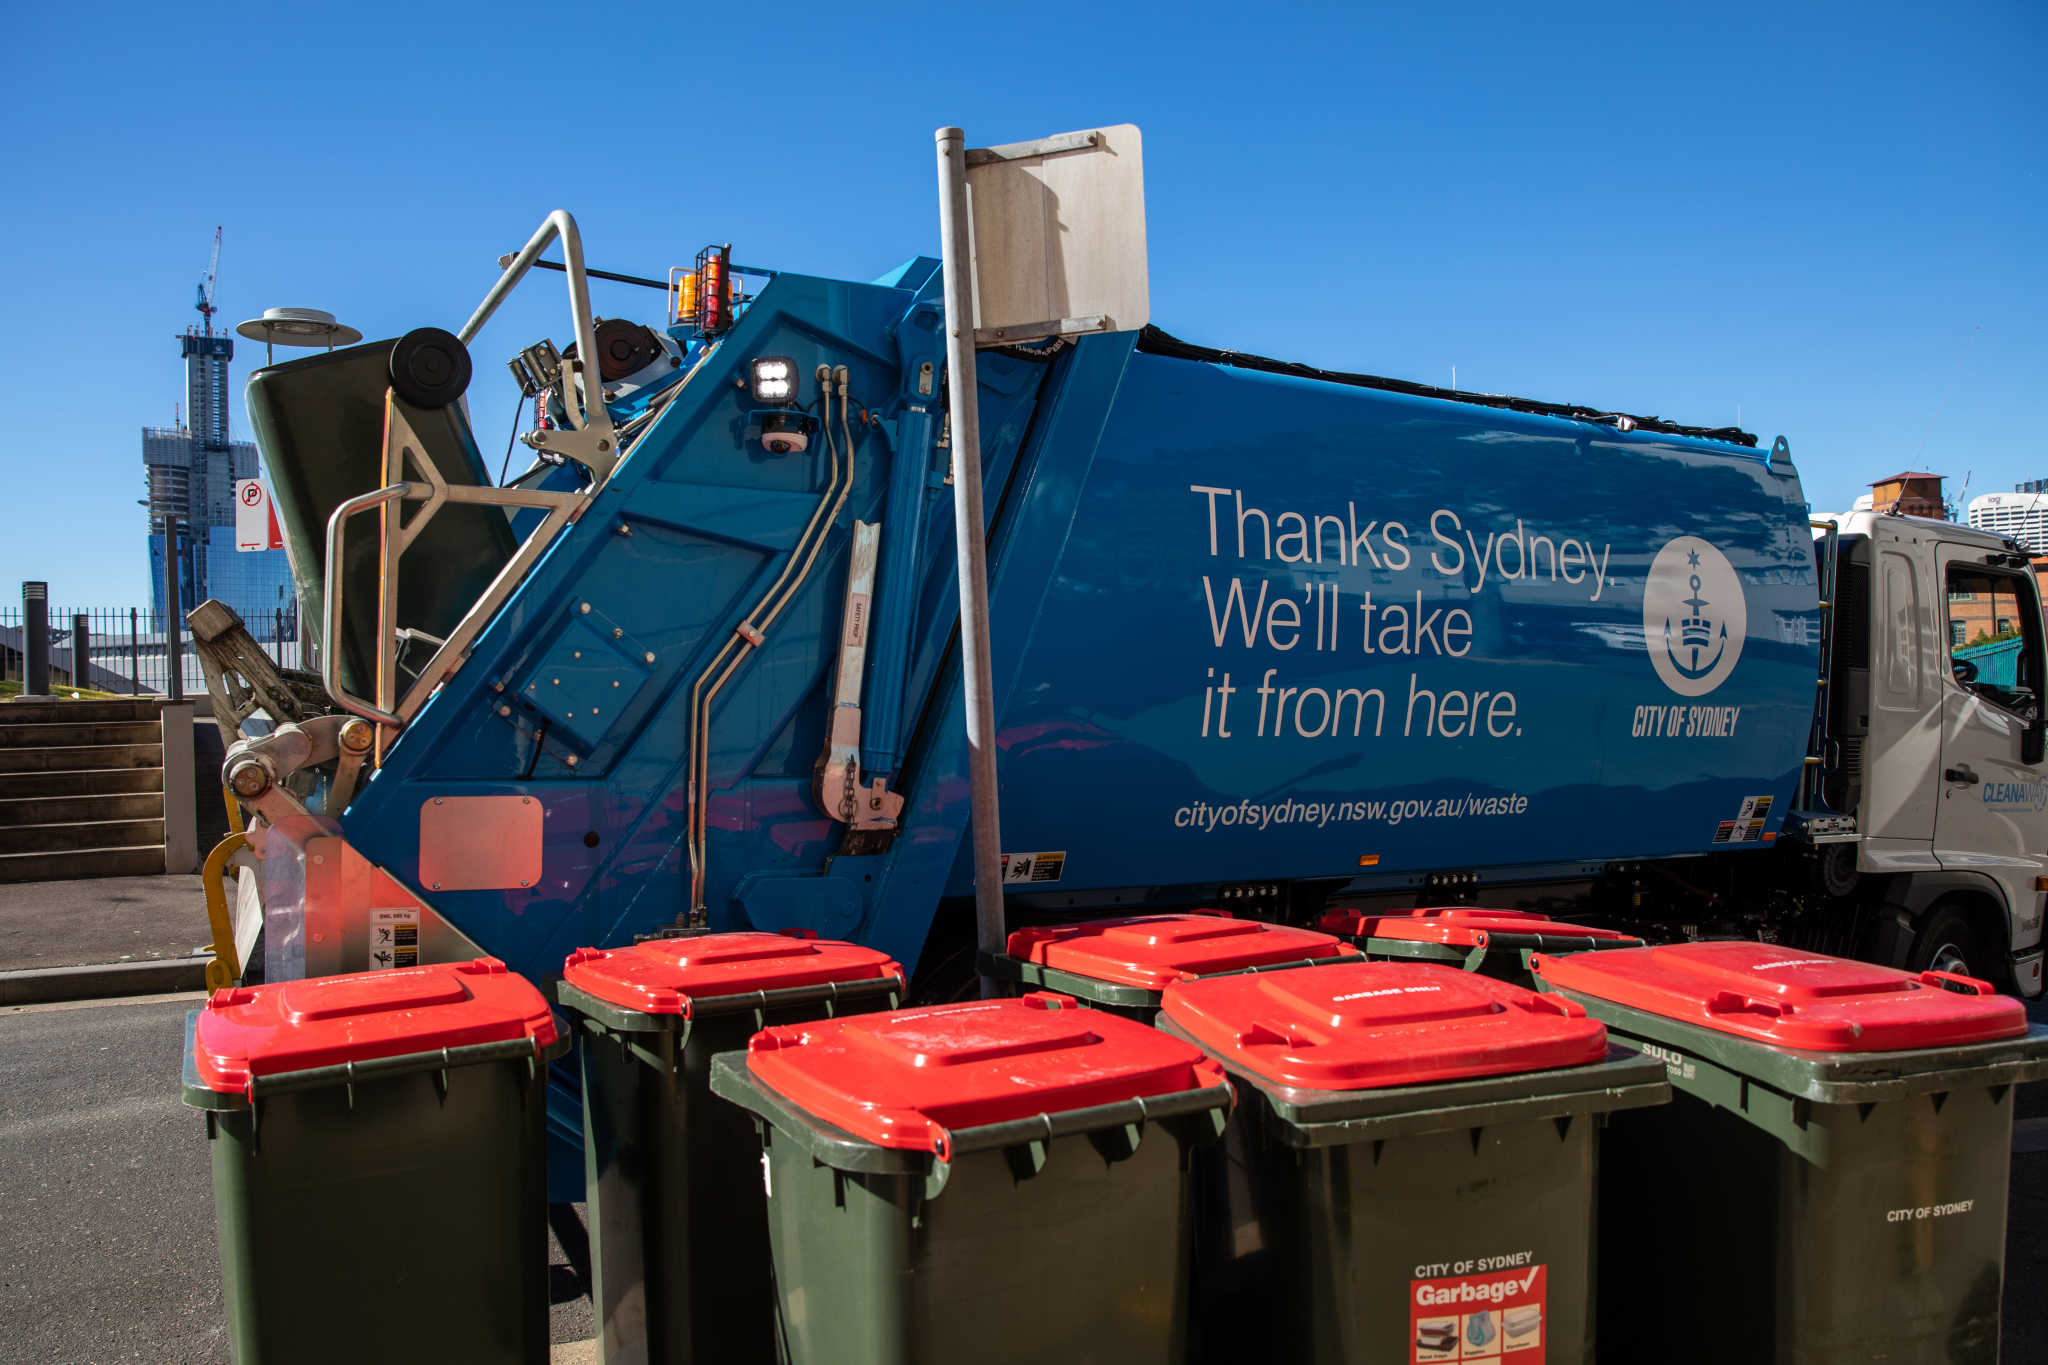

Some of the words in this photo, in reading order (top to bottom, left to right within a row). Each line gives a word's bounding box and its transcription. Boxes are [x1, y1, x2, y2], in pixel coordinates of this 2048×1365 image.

[1190, 485, 1411, 571] Thanks
[1430, 509, 1616, 602] Sydney.
[1202, 575, 1339, 651] We'll
[1360, 589, 1474, 657] take
[1202, 667, 1237, 738] it
[1257, 669, 1385, 738] from
[1404, 673, 1522, 738] here.
[1631, 705, 1668, 738] CITY
[1666, 705, 1688, 738] OF
[1685, 705, 1741, 738] SYDNEY
[1174, 793, 1528, 833] cityofsydney.nsw.gov.au/waste
[1642, 1043, 1683, 1065] SULO
[1886, 1208, 1915, 1222] CITY
[1915, 1207, 1932, 1219] OF
[1932, 1199, 1975, 1217] SYDNEY
[1415, 1262, 1449, 1277] CITY
[1453, 1259, 1474, 1274] OF
[1477, 1251, 1532, 1271] SYDNEY
[1416, 1281, 1518, 1304] Garbage
